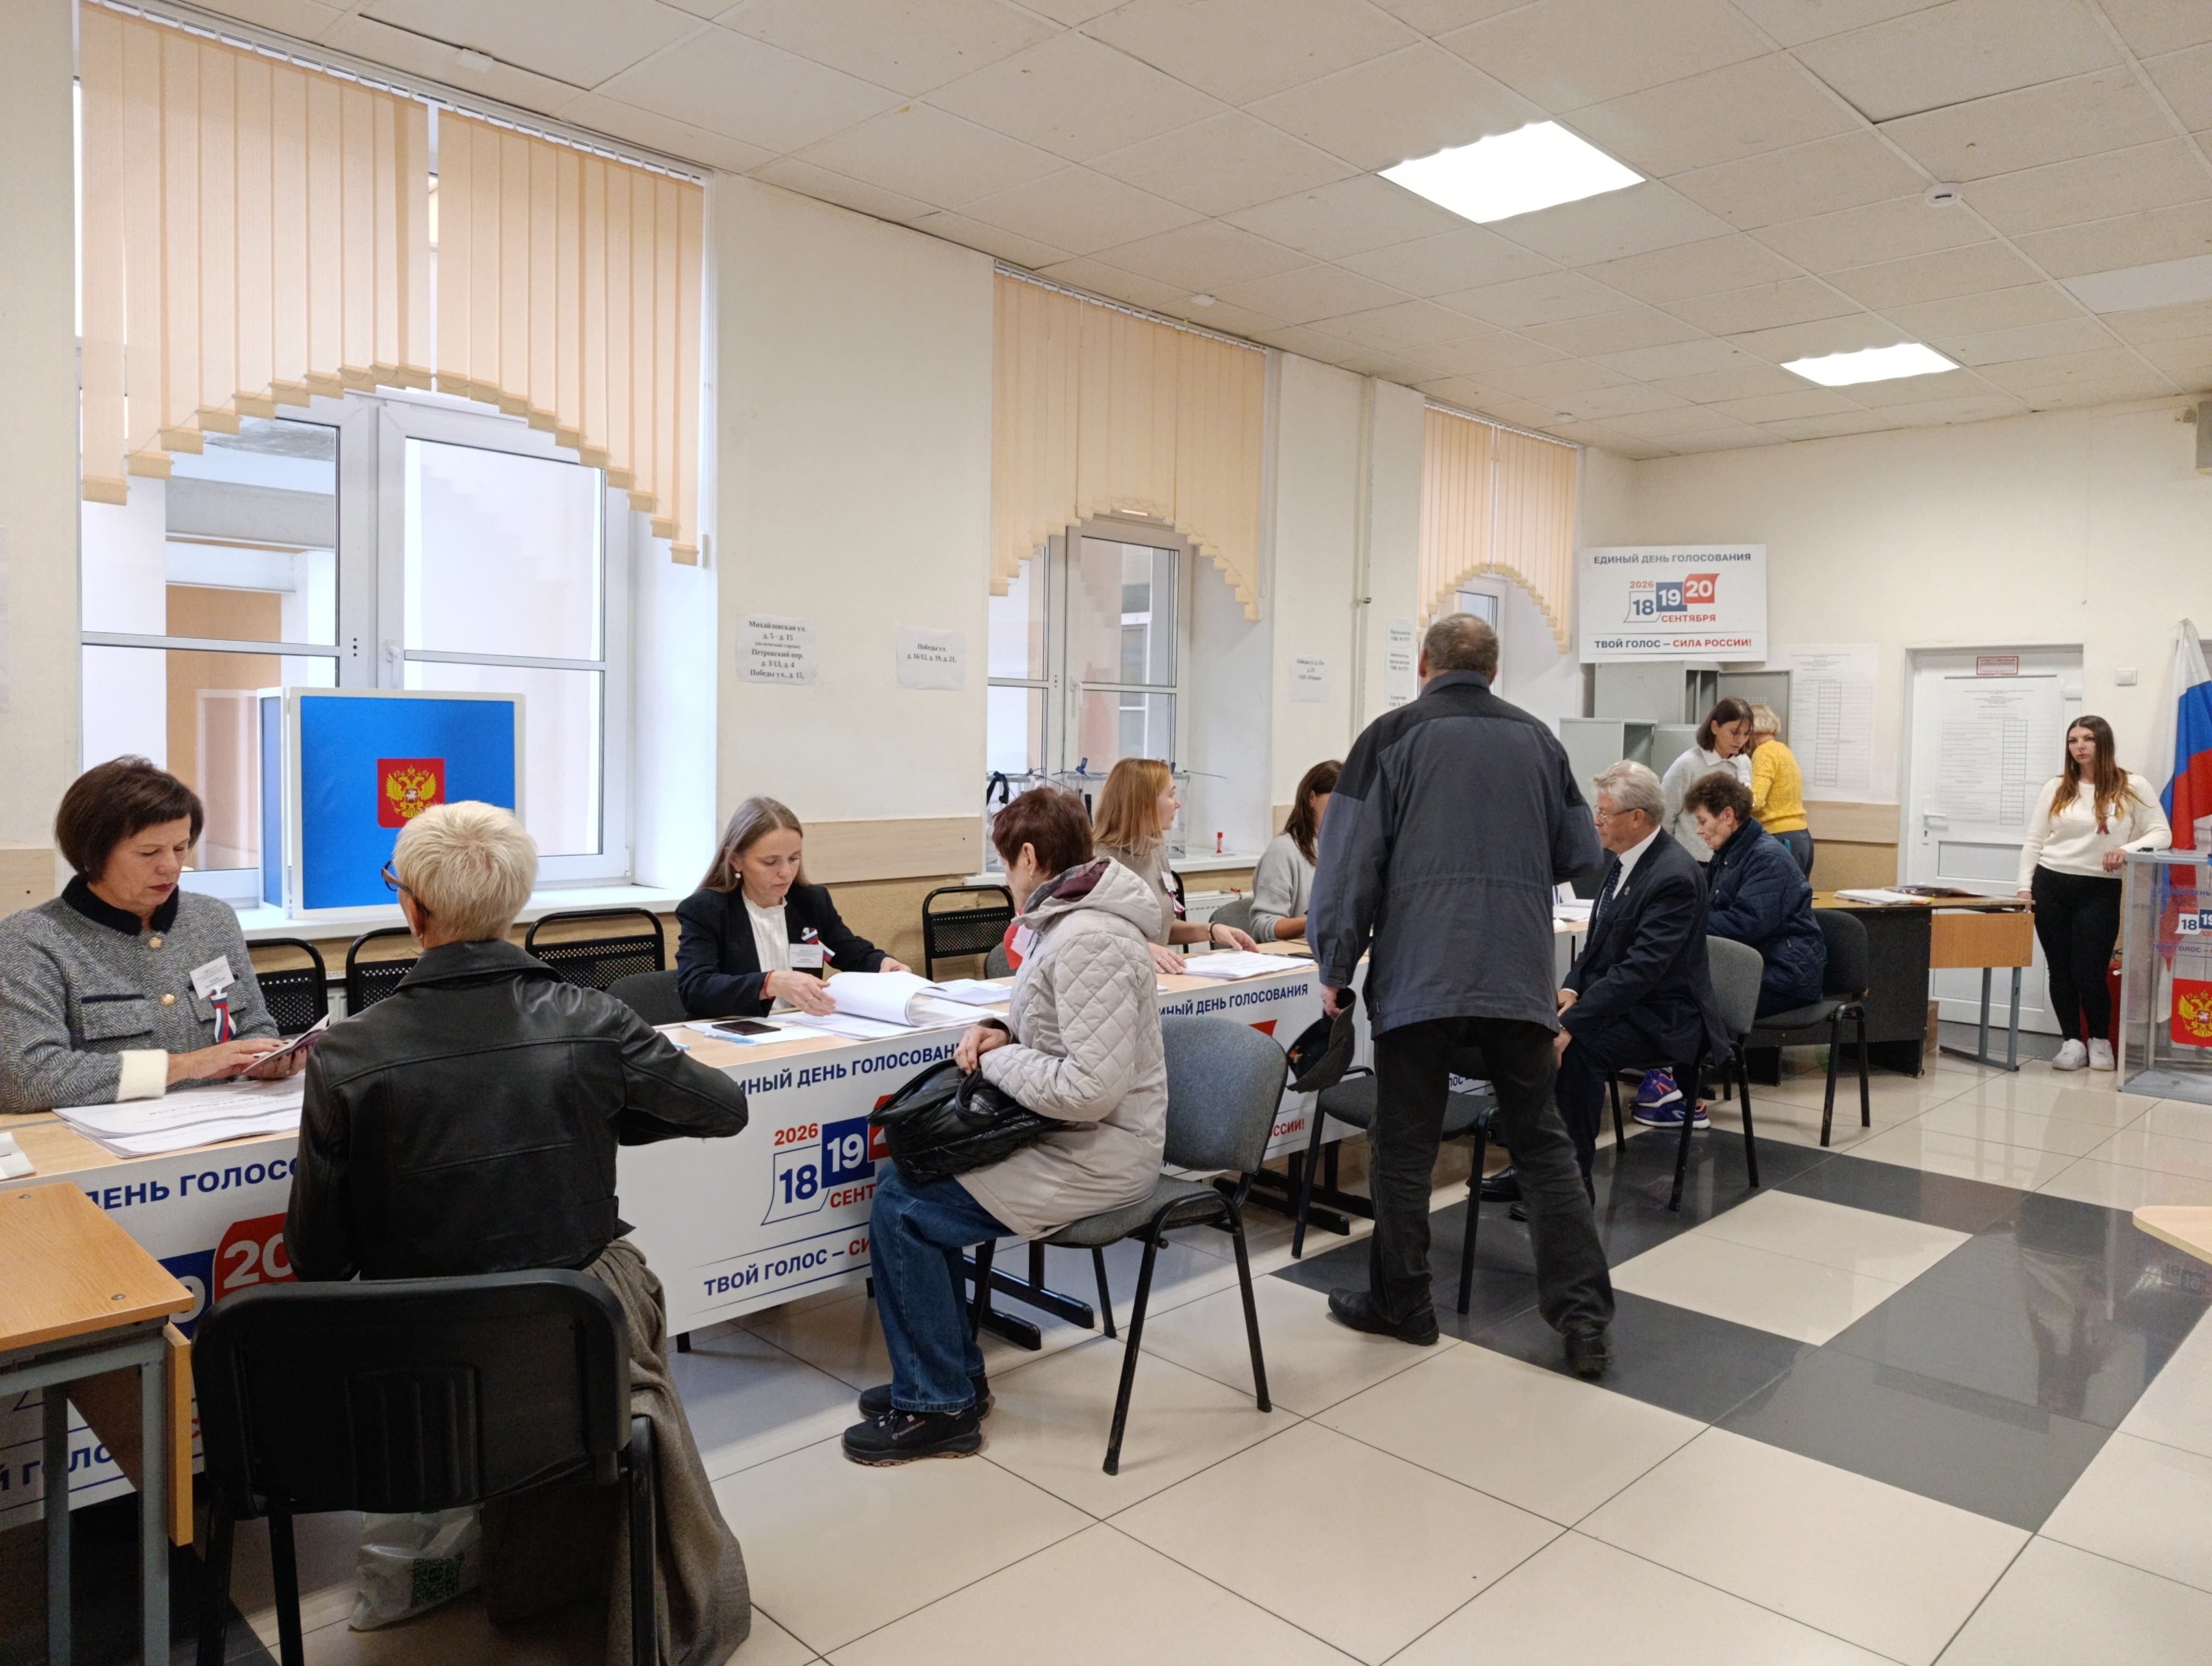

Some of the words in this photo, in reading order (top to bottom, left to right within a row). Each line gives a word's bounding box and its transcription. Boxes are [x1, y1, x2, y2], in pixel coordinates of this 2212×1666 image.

[1594, 554, 1639, 565] ЕДИНЫЙ
[1641, 554, 1669, 564] ДЕНЬ
[1672, 553, 1751, 562] ГОЛОСОВАНИЯ
[1632, 599, 1654, 616] 18
[1658, 589, 1681, 606] 19
[1686, 580, 1713, 597] 20
[749, 620, 796, 631] Михайловская
[1661, 614, 1716, 623] СЕНТЯБРЯ
[751, 649, 790, 657] Петровский
[1594, 638, 1623, 649] ТВОЙ
[1625, 640, 1661, 648] ГОЛОС
[1673, 639, 1702, 648] СИЛА
[1705, 638, 1752, 647] РОССИИ!
[750, 669, 775, 677] Победы
[2181, 919, 2197, 930] 18
[1159, 999, 1193, 1015] ИНЫЙ
[1196, 998, 1226, 1015] ДЕНЬ
[1229, 984, 1308, 1008] ГОЛОСОВАНИЯ
[738, 1068, 792, 1095] ИНЫЙ
[797, 1063, 847, 1088] ДЕНЬ
[852, 1043, 959, 1076] ГОЛОСОВАН
[774, 1123, 819, 1146] 2026
[1273, 1118, 1304, 1137] ССИИ!
[779, 1164, 818, 1204] 18
[827, 1133, 865, 1172] 19
[830, 1183, 877, 1208] СЕНТ
[223, 1233, 293, 1289] 20
[704, 1265, 758, 1296] ТВОЙ
[764, 1249, 827, 1280] ГОЛОС
